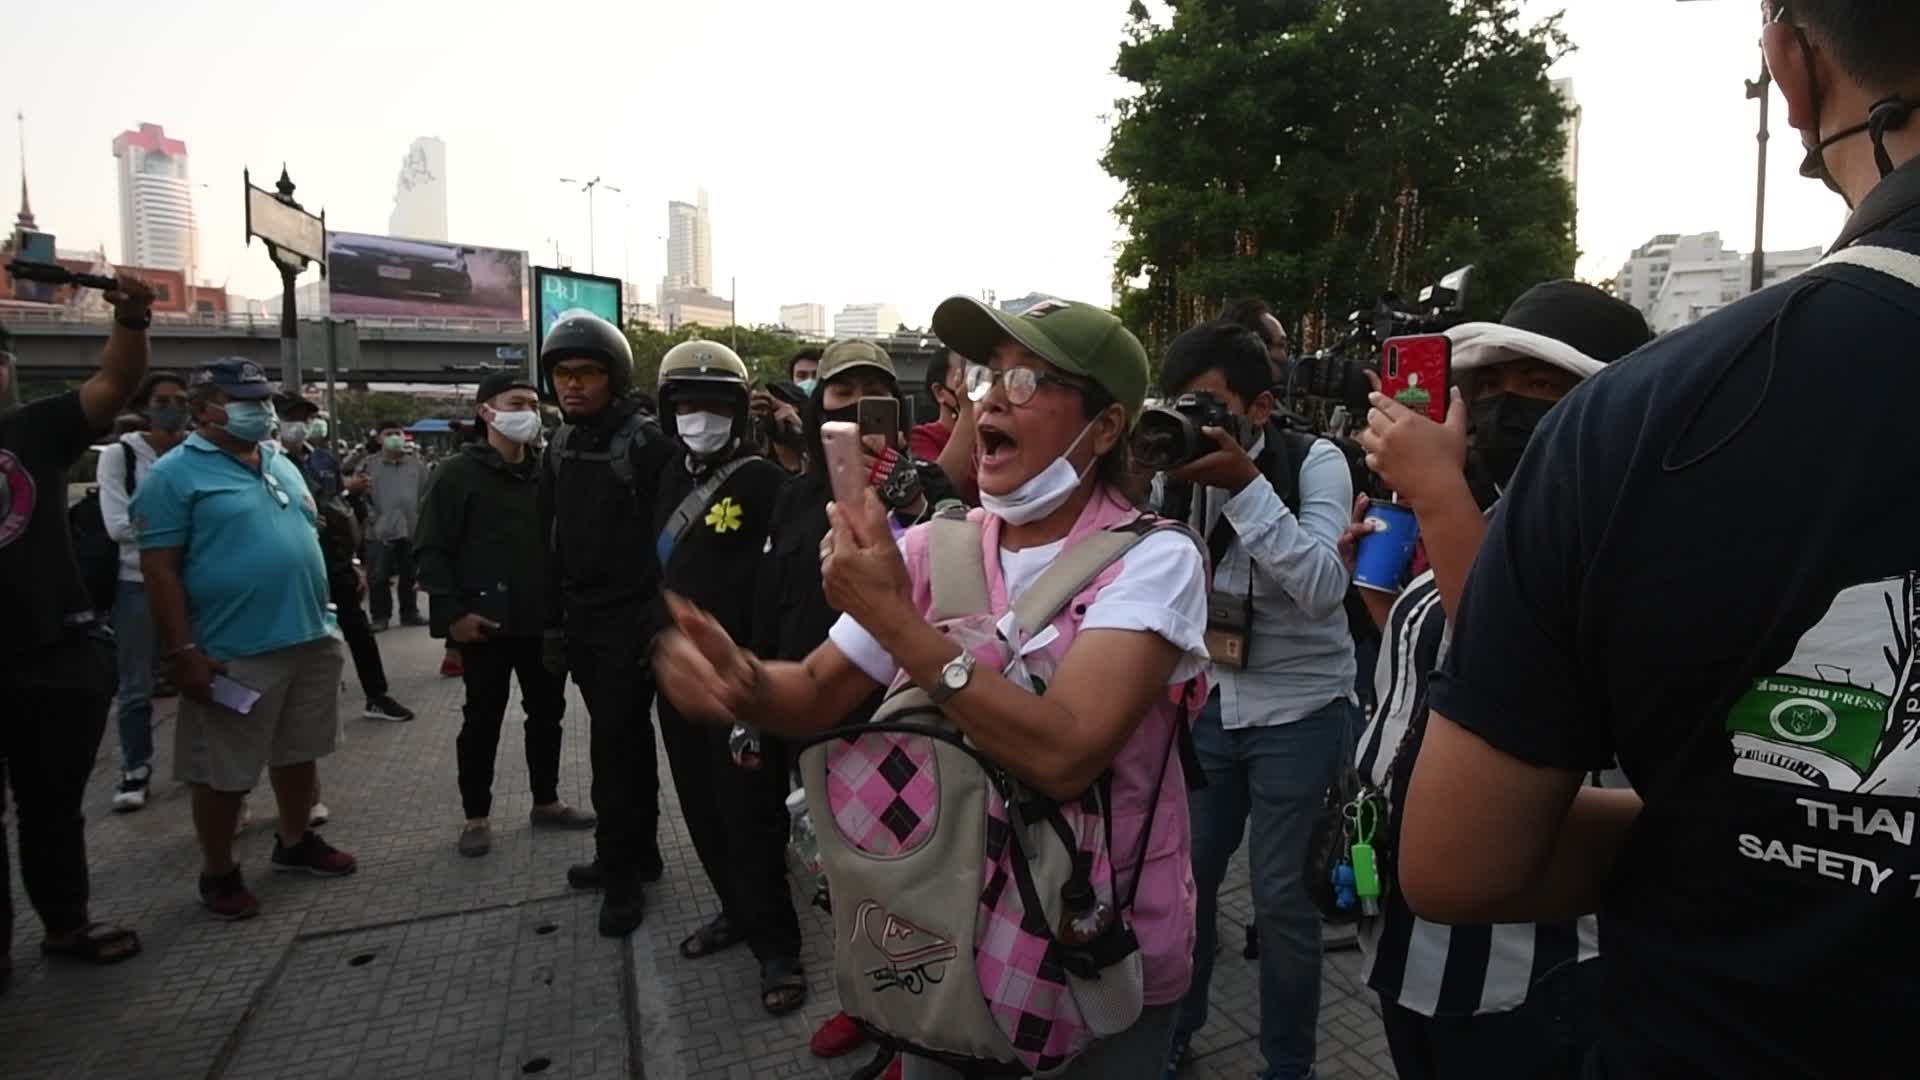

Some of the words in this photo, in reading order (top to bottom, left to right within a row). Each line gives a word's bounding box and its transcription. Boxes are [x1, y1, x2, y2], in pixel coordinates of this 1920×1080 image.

[1832, 691, 1885, 711] PRESS
[1796, 798, 1915, 846] THAI
[1738, 833, 1894, 894] SAFETY
